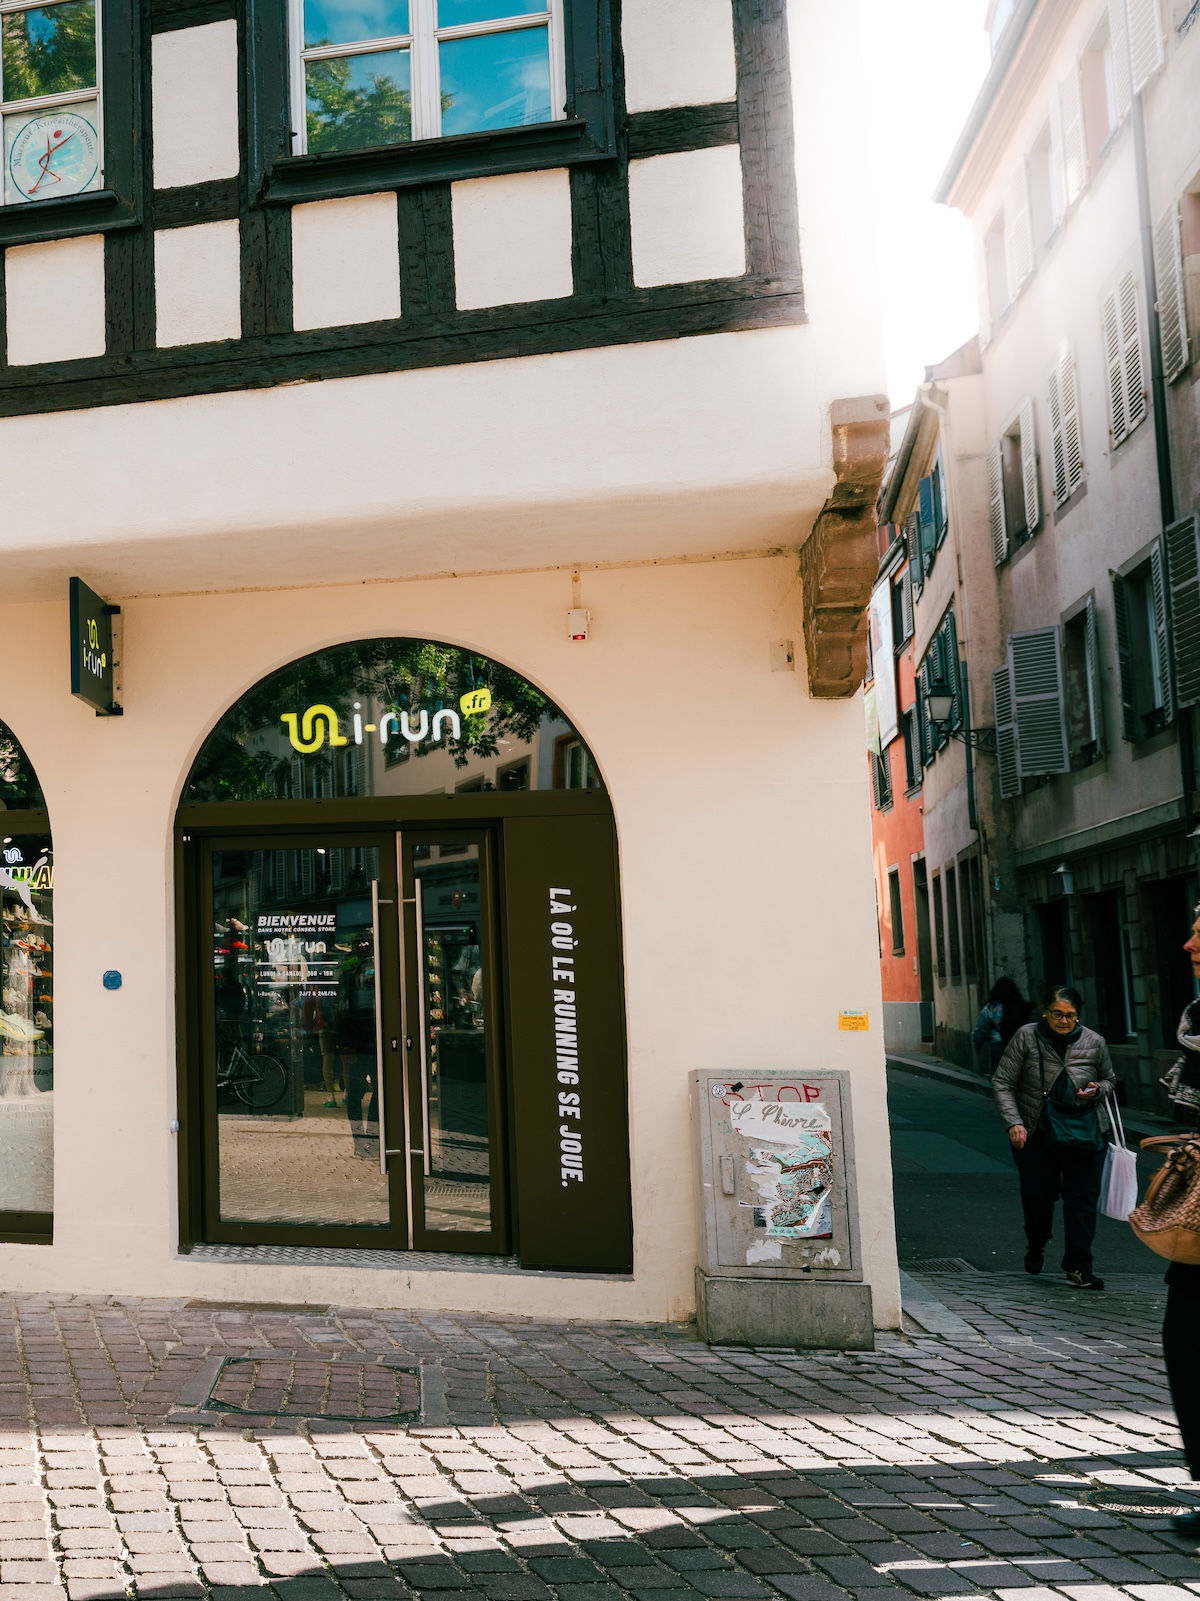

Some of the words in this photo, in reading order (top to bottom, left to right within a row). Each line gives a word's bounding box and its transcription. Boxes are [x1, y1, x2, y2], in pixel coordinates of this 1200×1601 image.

[83, 640, 103, 679] i-run
[353, 702, 461, 744] i-run
[550, 887, 577, 914] LÀ
[257, 915, 336, 926] BIENVENUE
[551, 922, 579, 950] OÙ
[552, 957, 575, 983] LE
[554, 989, 580, 1085] RUNNING
[558, 1091, 581, 1119] SE
[560, 1125, 584, 1187] JOUE.
